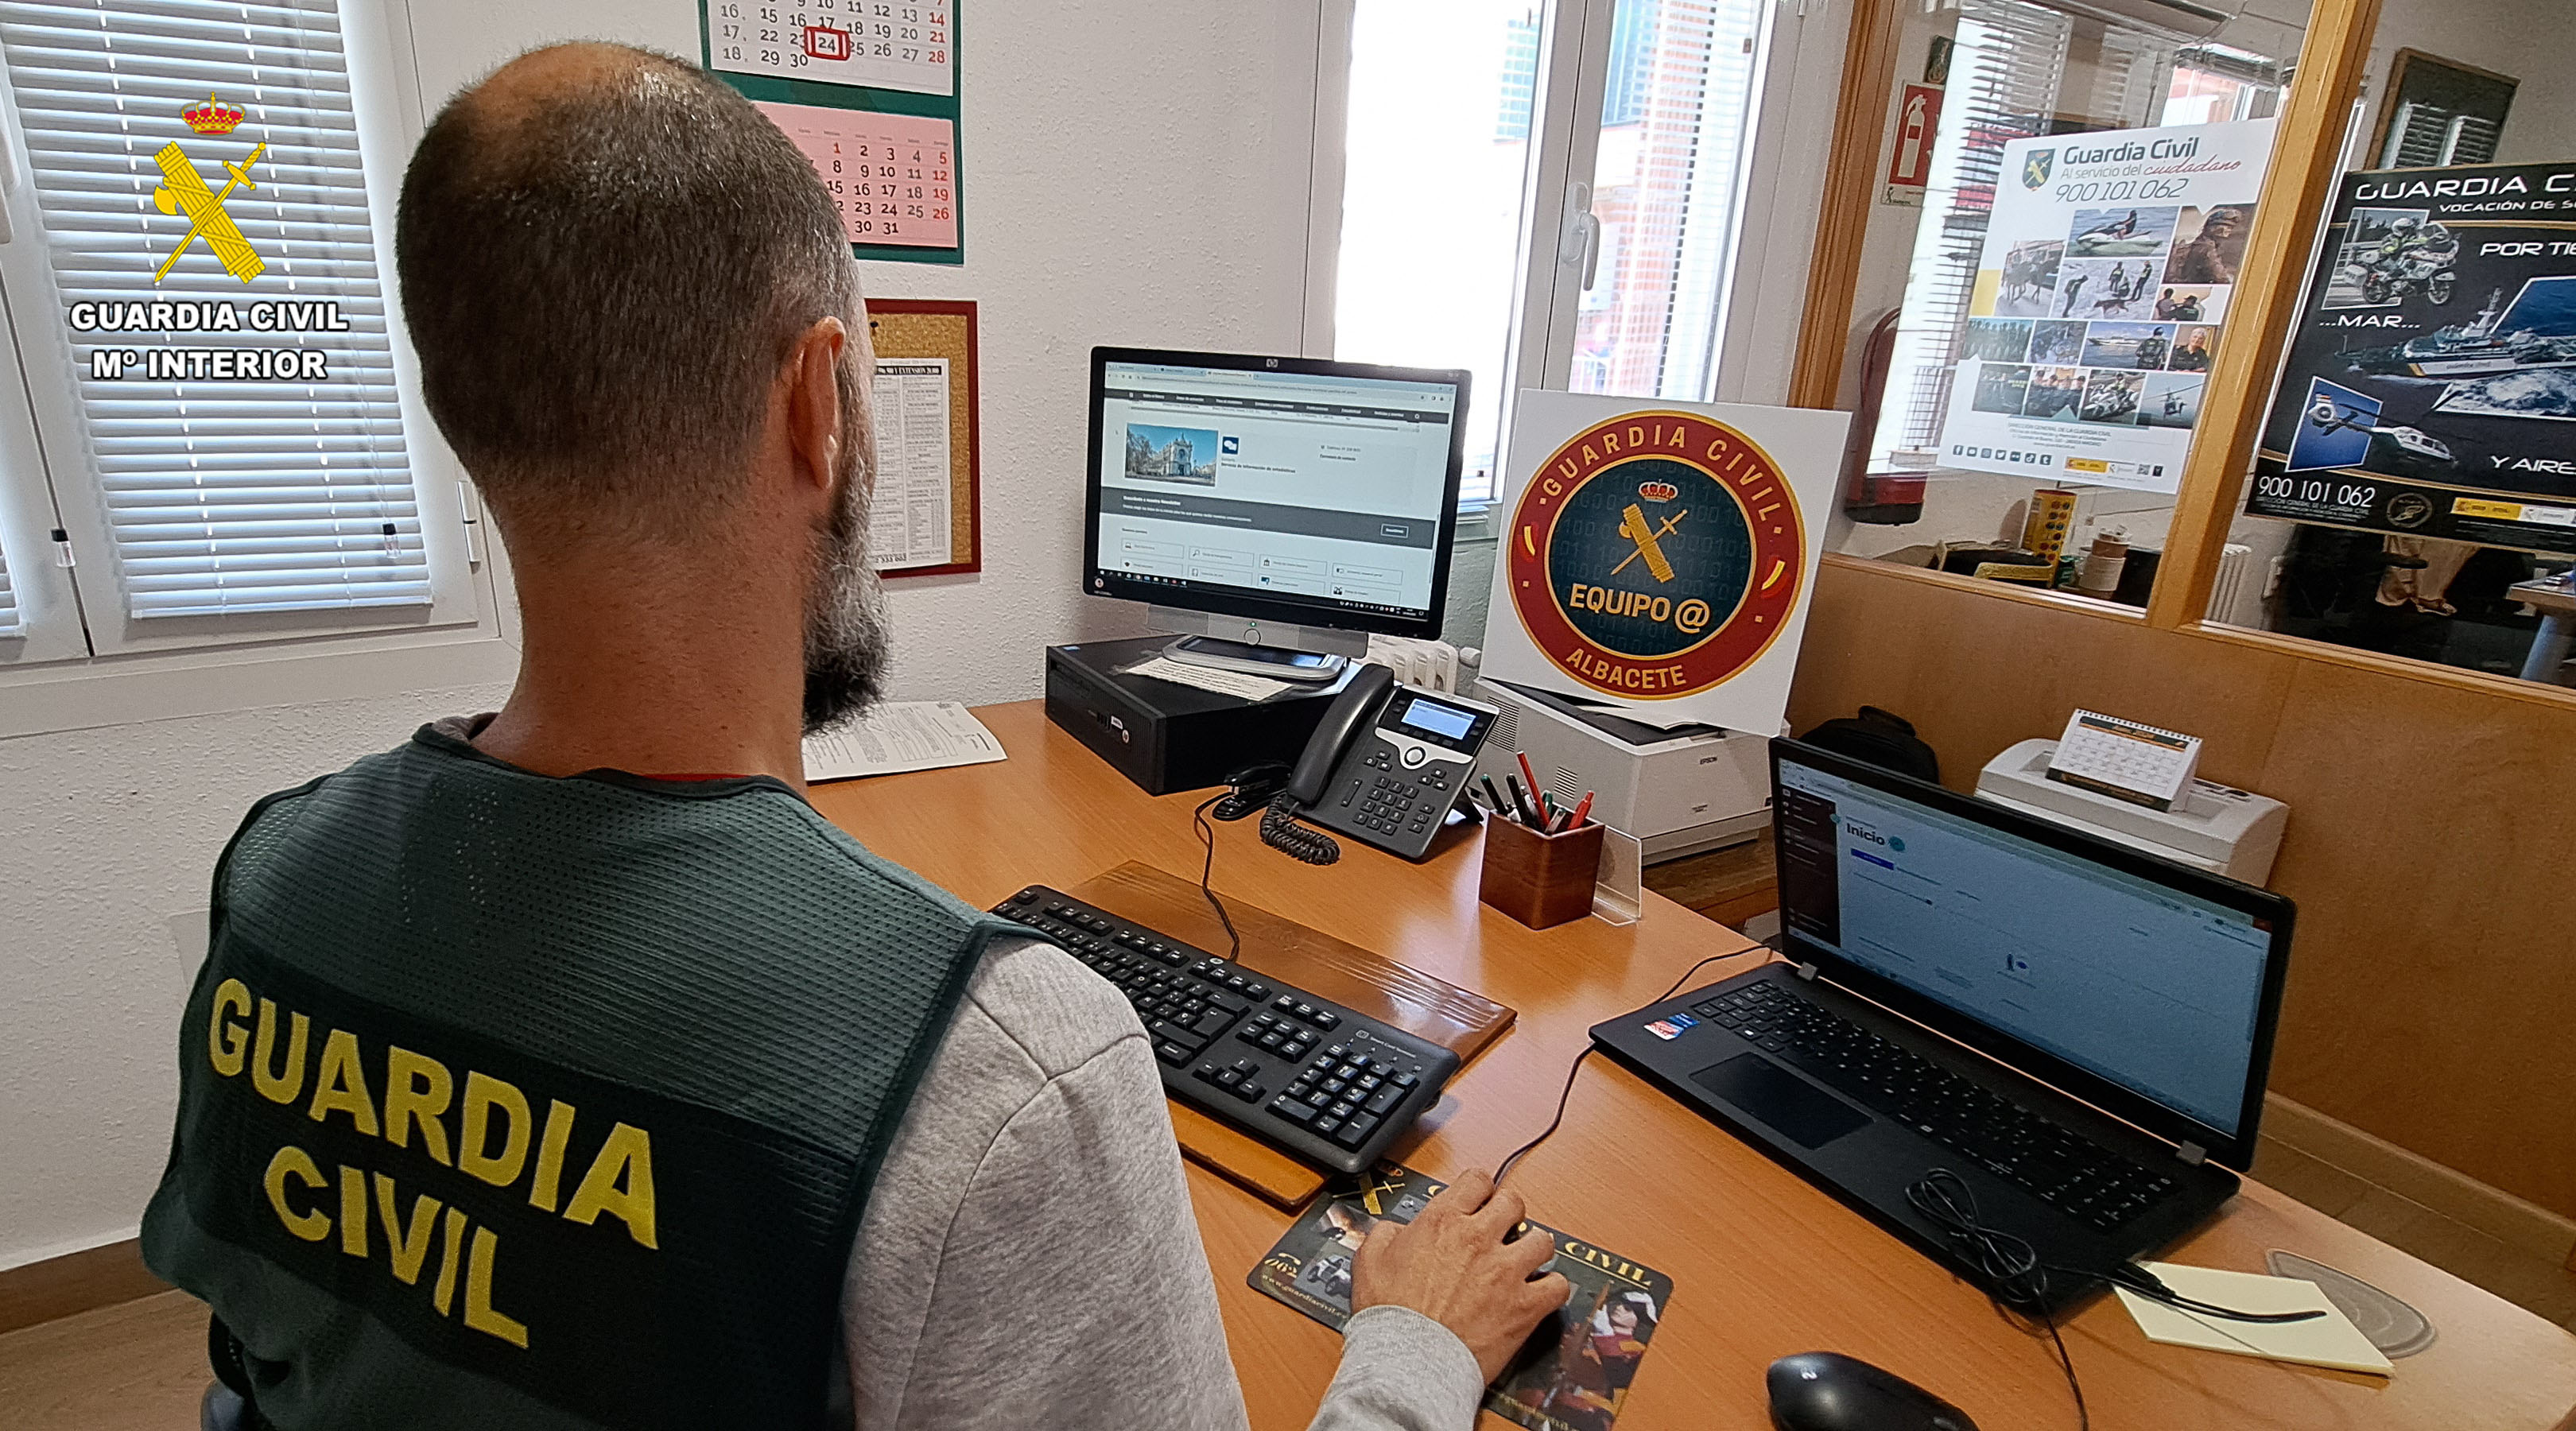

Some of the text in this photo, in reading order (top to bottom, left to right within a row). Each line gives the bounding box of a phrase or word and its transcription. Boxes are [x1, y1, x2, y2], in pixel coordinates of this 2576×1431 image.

[760, 7, 778, 23] 15
[789, 14, 806, 27] 16
[818, 16, 835, 29] 17
[847, 21, 863, 35] 18
[875, 24, 891, 39] 19
[901, 28, 918, 40] 20
[929, 31, 945, 44] 21
[848, 1, 863, 14] 11
[875, 5, 890, 17] 12
[902, 9, 918, 23] 13
[929, 12, 945, 26] 14
[760, 29, 778, 42] 22
[818, 37, 836, 53] 24
[875, 43, 892, 56] 26
[902, 48, 919, 62] 27
[929, 50, 945, 64] 28
[761, 49, 780, 65] 29
[789, 53, 809, 68] 30
[833, 142, 948, 165] 1 2 3 4 5
[2063, 137, 2200, 165] Guardia Civil
[833, 160, 948, 181] 8 9 10 11 12
[2061, 154, 2242, 179] Al servicio del ciudadano
[827, 180, 949, 201] 15 16 17 18 19
[2056, 178, 2189, 203] 900 101 062
[2354, 173, 2576, 200] GUARDIA C
[855, 201, 871, 215] 23
[881, 203, 898, 216] 24
[908, 204, 924, 218] 25
[933, 207, 949, 219] 26
[2439, 200, 2527, 213] VOCACIÓN
[2529, 200, 2555, 211] DE
[855, 220, 899, 235] 30 31
[2480, 242, 2544, 257] POR
[1544, 425, 1781, 522] GUARDIA CIVIL
[2489, 455, 2511, 468] Y
[2258, 476, 2376, 508] 900 101 062
[1569, 583, 1711, 634] EQUIPO @
[1565, 648, 1687, 690] ALBACETE
[1699, 756, 1718, 765] EPSON
[1846, 823, 1885, 846] Inicio
[208, 978, 658, 1251] GUARDIA
[263, 1146, 529, 1349] CIVIL
[1564, 1241, 1652, 1286] CIVIL
